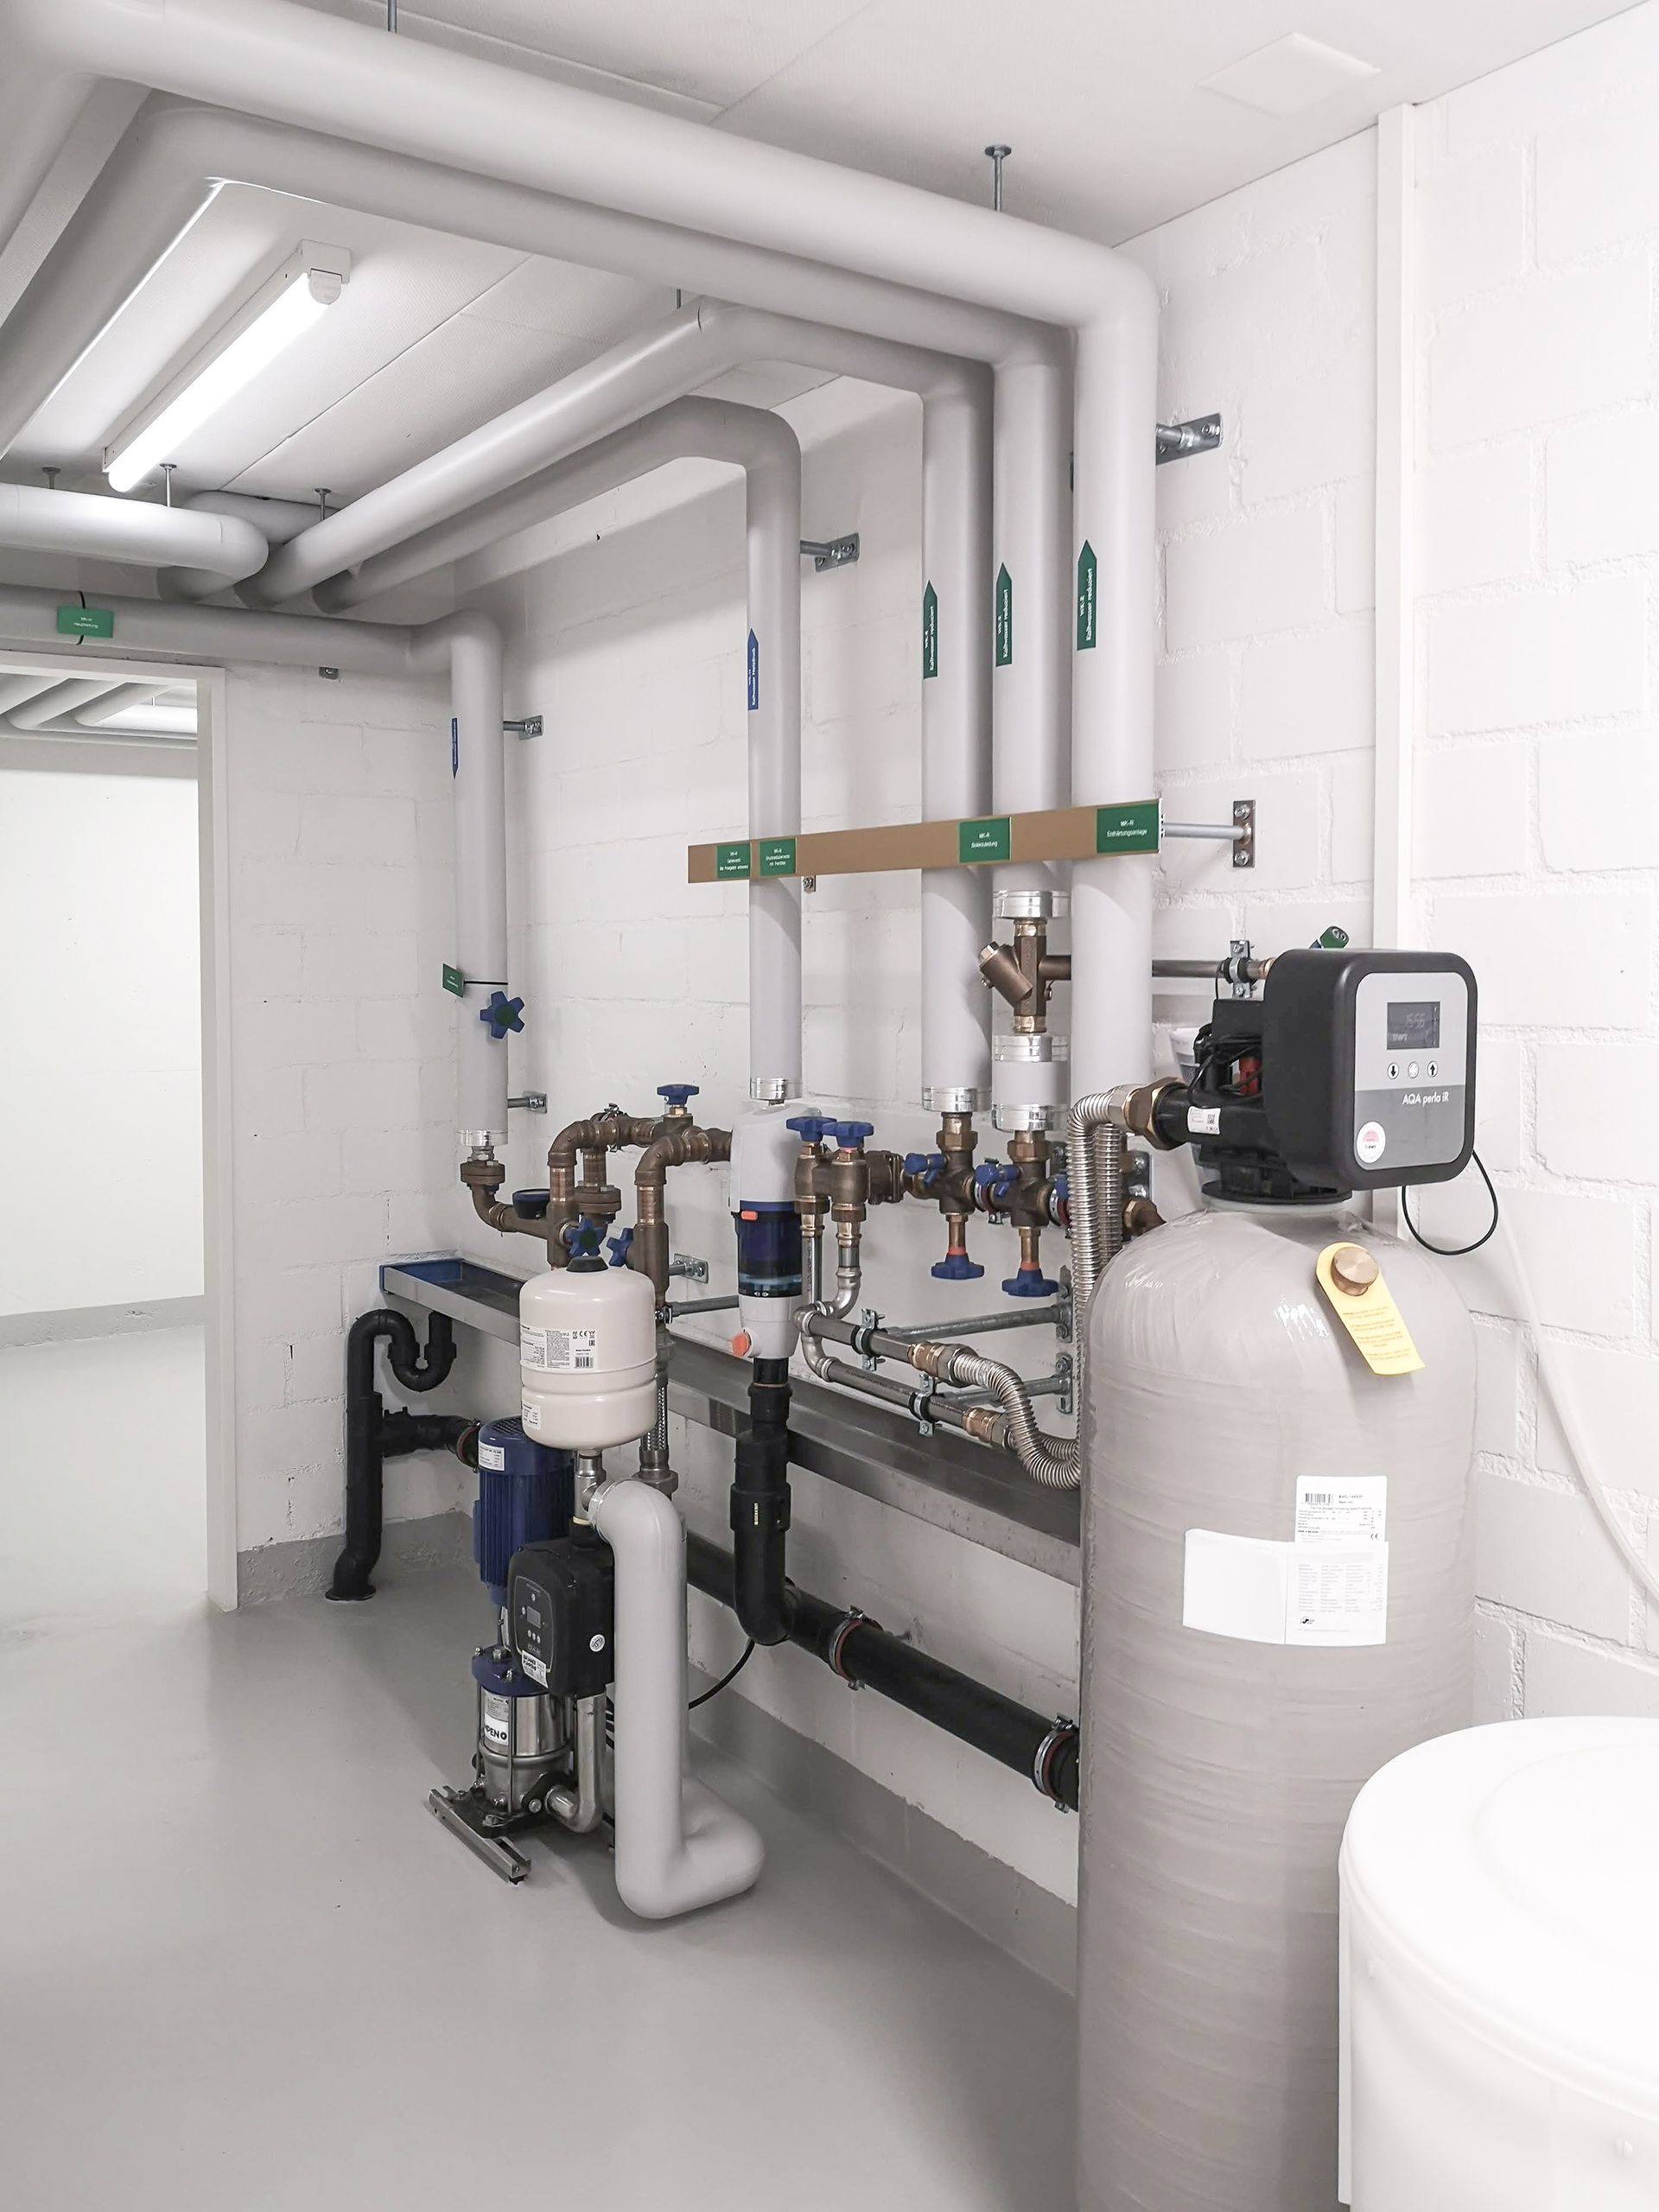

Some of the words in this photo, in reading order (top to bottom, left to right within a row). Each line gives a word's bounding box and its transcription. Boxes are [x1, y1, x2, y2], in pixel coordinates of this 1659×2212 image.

[1402, 1093, 1421, 1105] AQA
[1422, 1090, 1441, 1107] perla
[1441, 1090, 1449, 1103] iR
